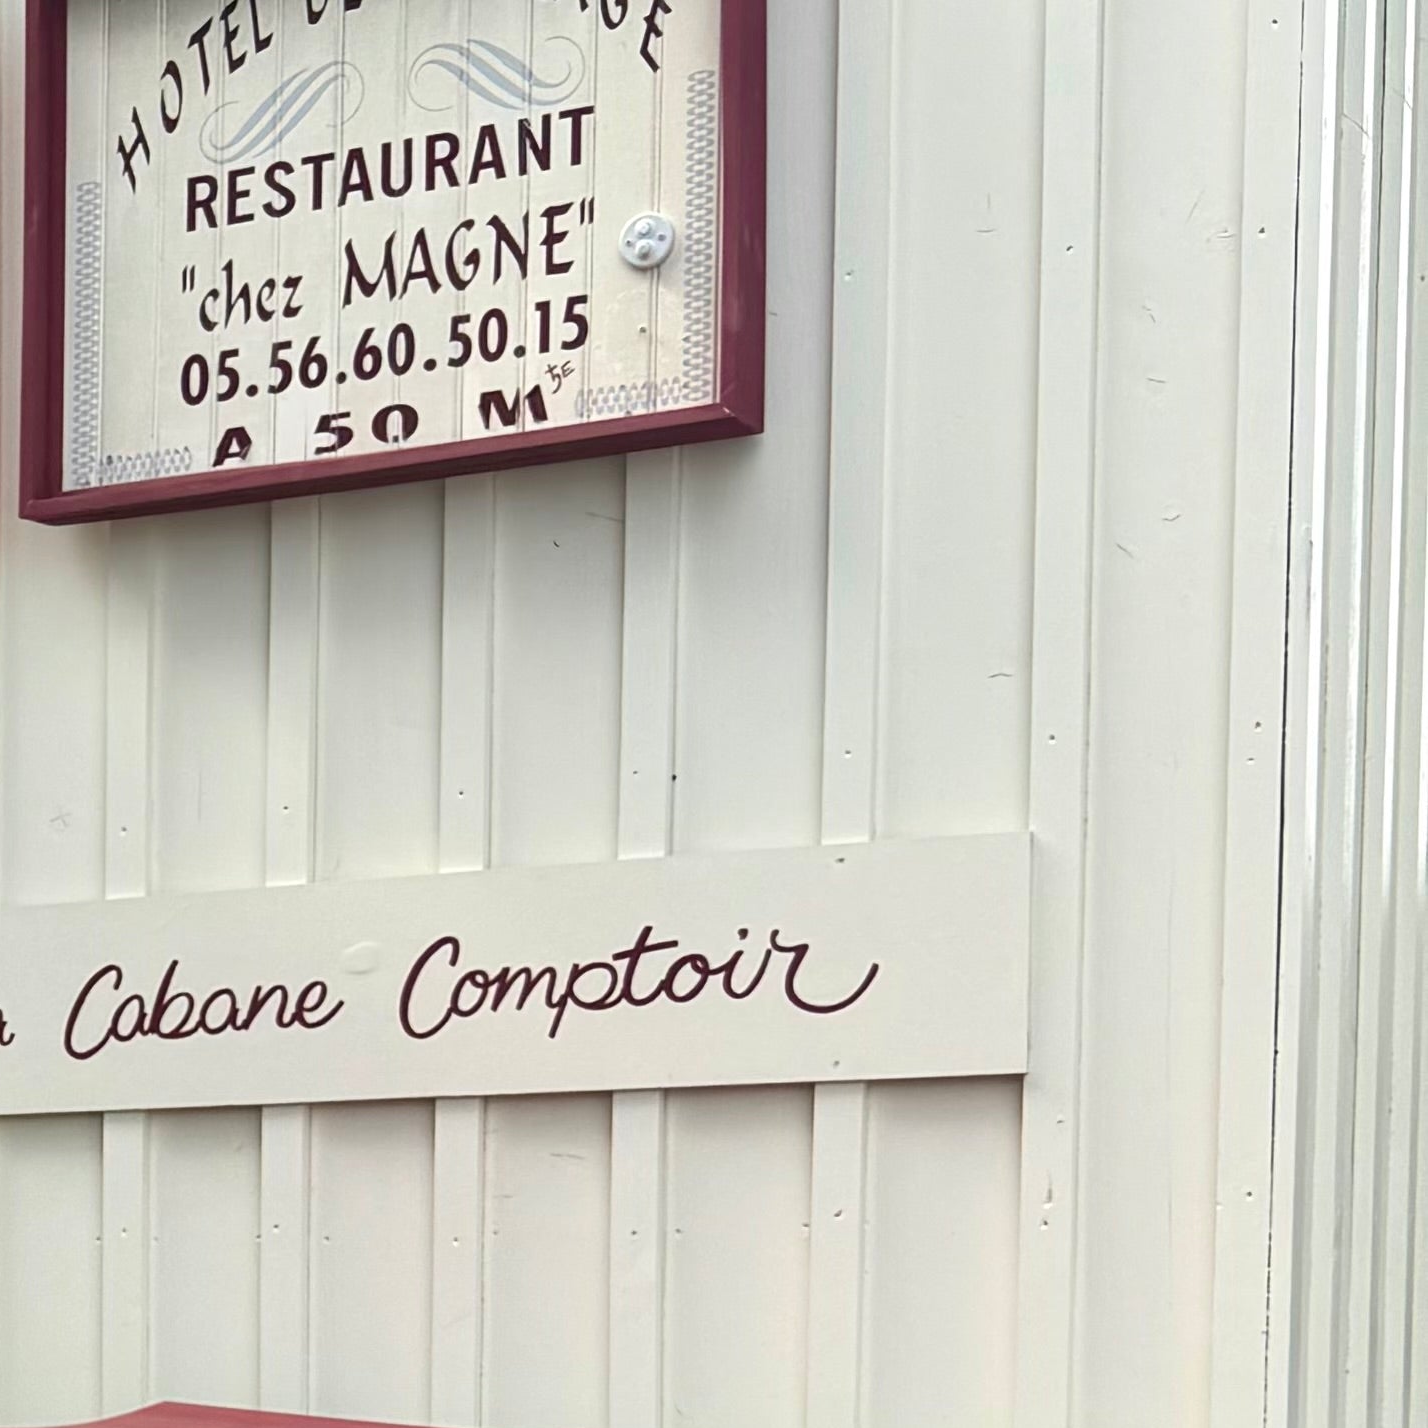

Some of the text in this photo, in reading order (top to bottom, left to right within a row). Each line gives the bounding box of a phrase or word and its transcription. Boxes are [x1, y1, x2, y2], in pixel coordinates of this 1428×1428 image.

[116, 0, 274, 196] HOTEL
[186, 105, 595, 232] RESTAURANT
[181, 197, 595, 332] "chez MAGNE"
[181, 294, 589, 406] 05.56.60.50.15
[212, 426, 253, 467] A
[313, 403, 419, 455] 50
[63, 959, 345, 1061] Cabane
[398, 925, 880, 1040] Comptoir
